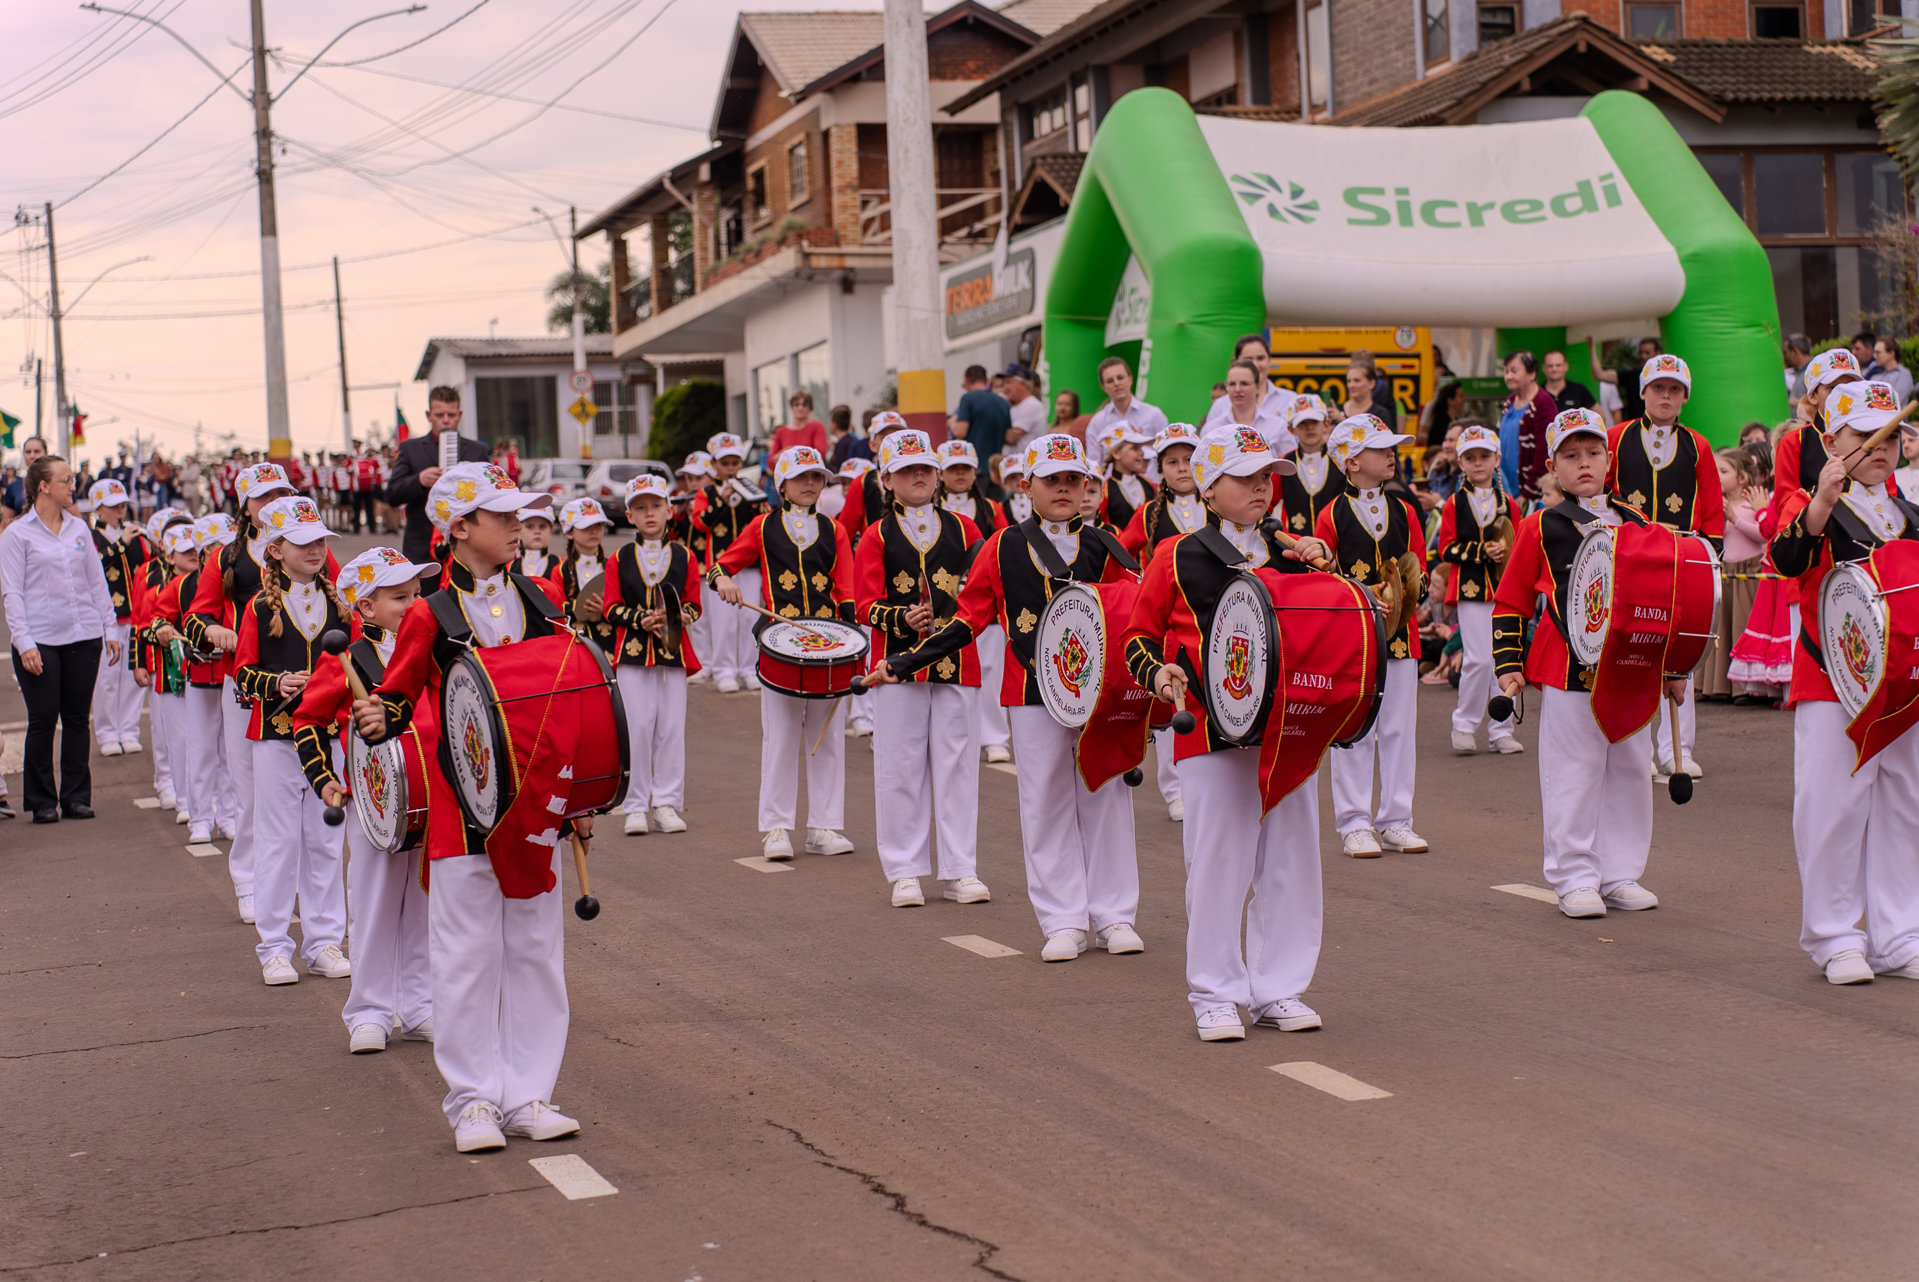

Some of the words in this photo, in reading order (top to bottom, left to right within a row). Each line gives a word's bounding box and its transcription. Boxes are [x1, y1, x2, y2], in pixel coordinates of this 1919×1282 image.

[1342, 172, 1623, 228] Sicredi
[1050, 599, 1094, 626] PREFEITURA
[1213, 591, 1245, 654] PREFEITURA
[1634, 606, 1667, 621] BANDA
[1630, 632, 1664, 644] MIRIM
[1292, 672, 1333, 690] BANDA
[1214, 683, 1224, 712] NOVA
[1286, 703, 1326, 715] MIRIM
